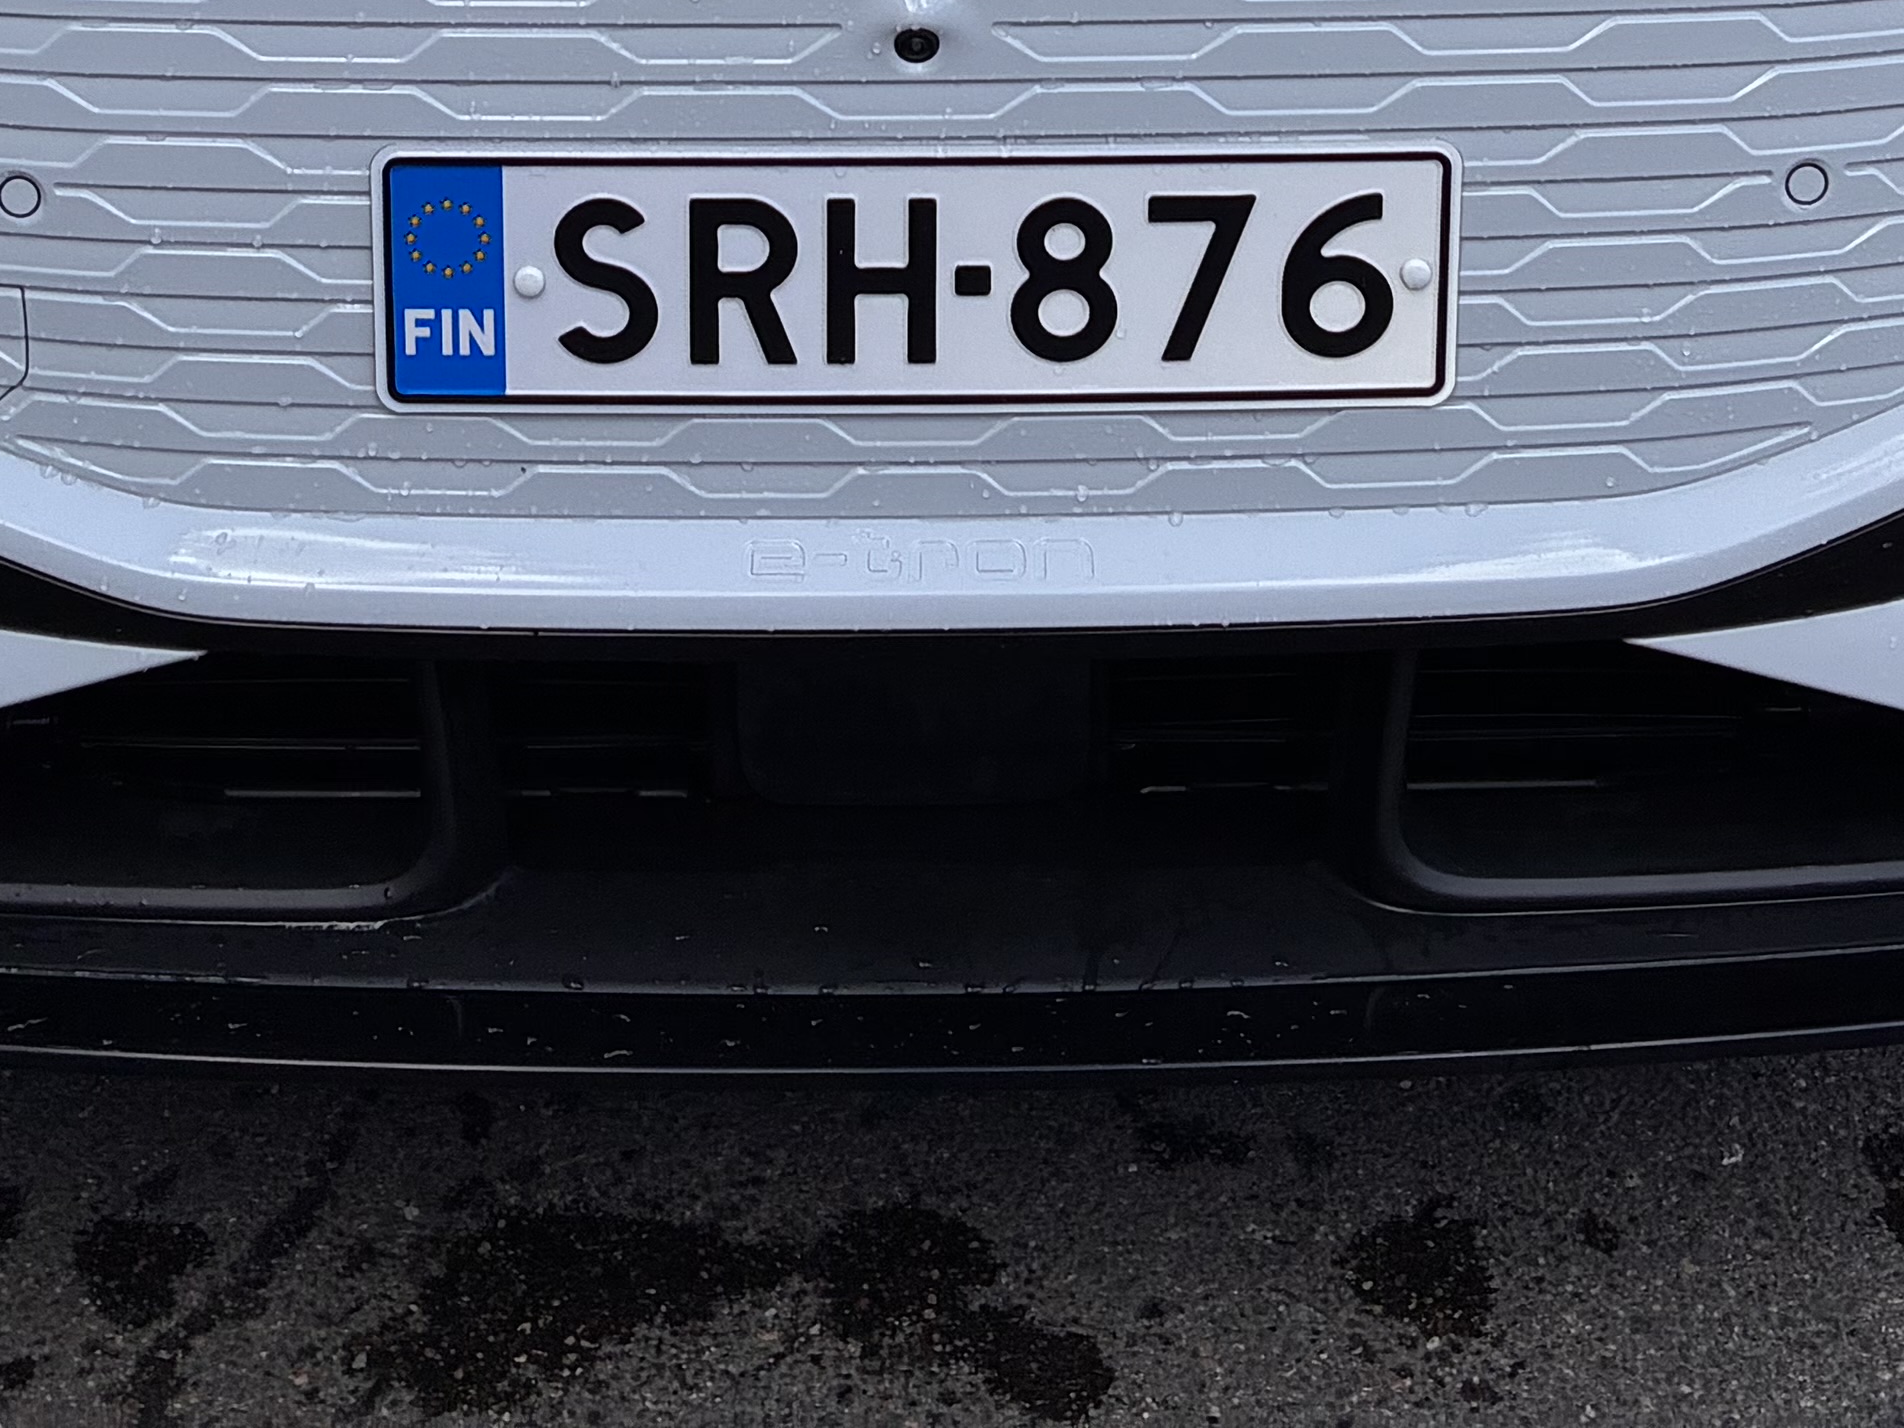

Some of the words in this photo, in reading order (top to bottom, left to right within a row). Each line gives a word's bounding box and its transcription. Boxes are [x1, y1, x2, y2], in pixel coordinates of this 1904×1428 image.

[554, 194, 1393, 365] SRH-876
[404, 309, 496, 356] FIN
[746, 528, 1096, 582] e-tron
